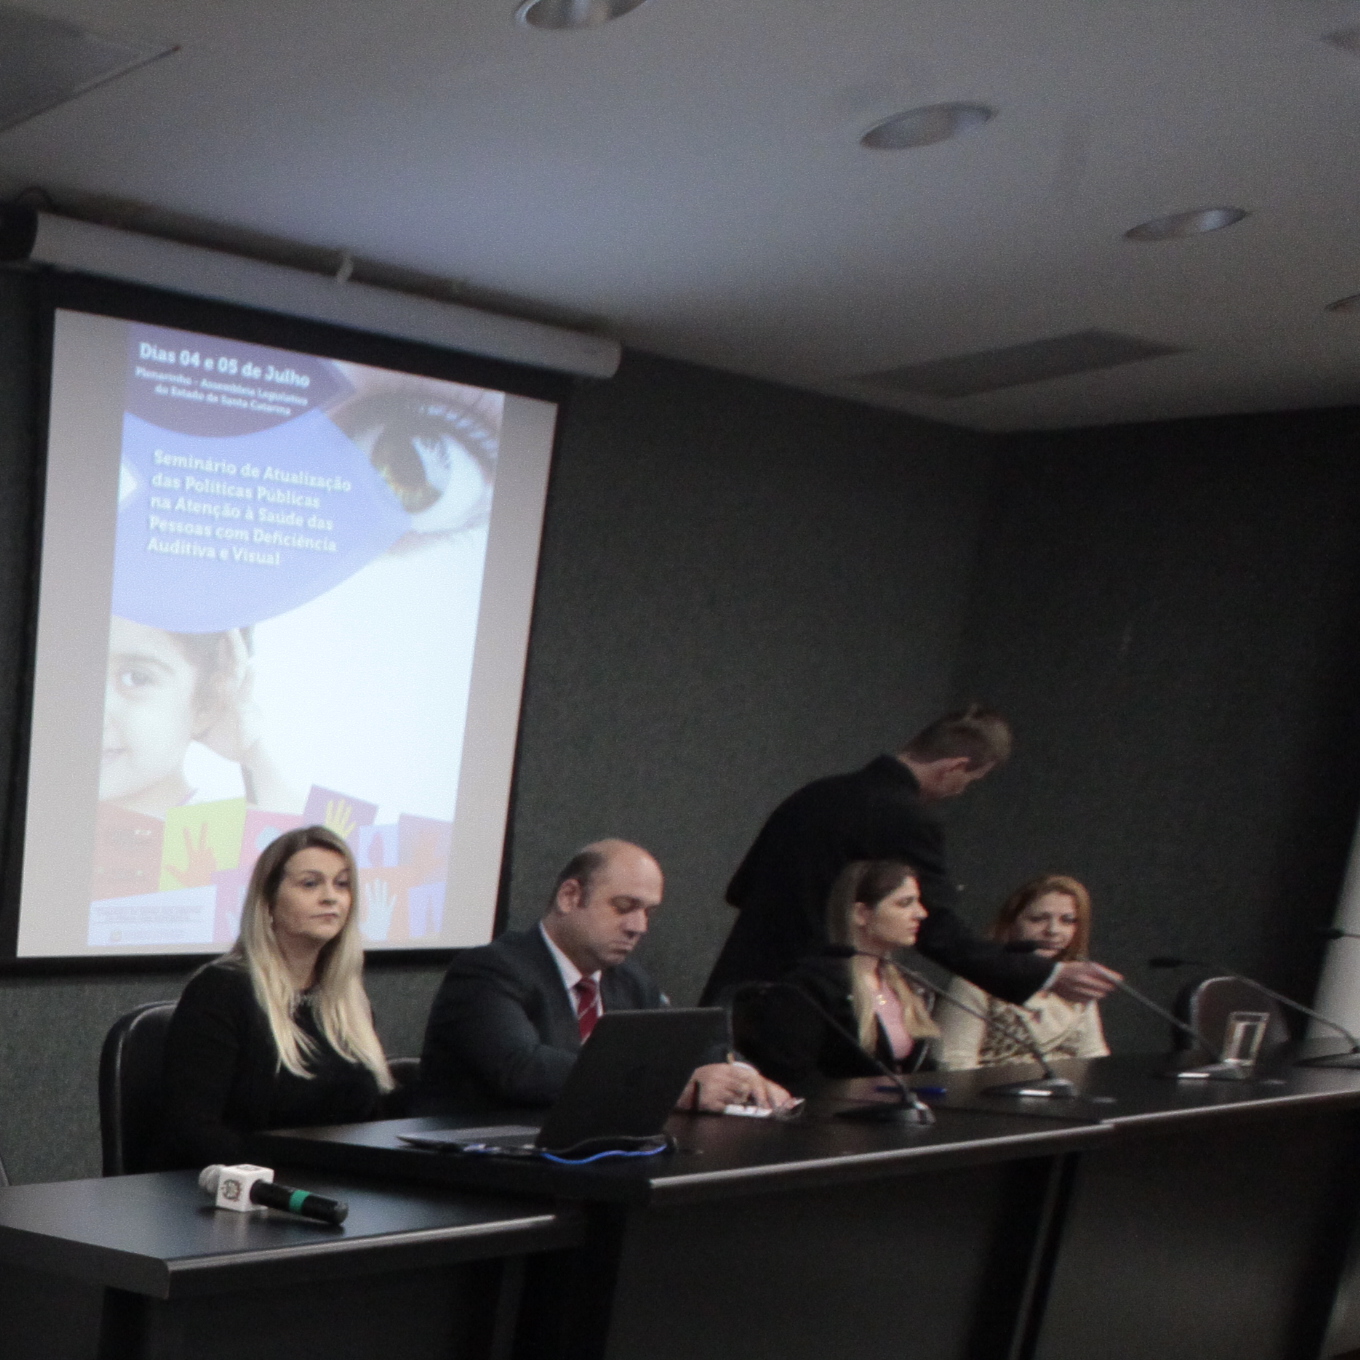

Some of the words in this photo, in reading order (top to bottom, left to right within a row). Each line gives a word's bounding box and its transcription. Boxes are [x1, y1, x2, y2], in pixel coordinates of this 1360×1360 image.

[139, 342, 176, 364] Dias
[180, 349, 200, 368] 04
[204, 357, 214, 371] e
[217, 357, 238, 375] 05
[241, 362, 262, 379] de
[265, 365, 311, 388] Julho
[151, 473, 180, 489] das
[240, 463, 260, 478] de
[150, 496, 171, 510] na
[307, 515, 333, 531] das
[149, 515, 212, 537] Pessoas
[215, 526, 250, 541] com
[218, 548, 229, 560] e
